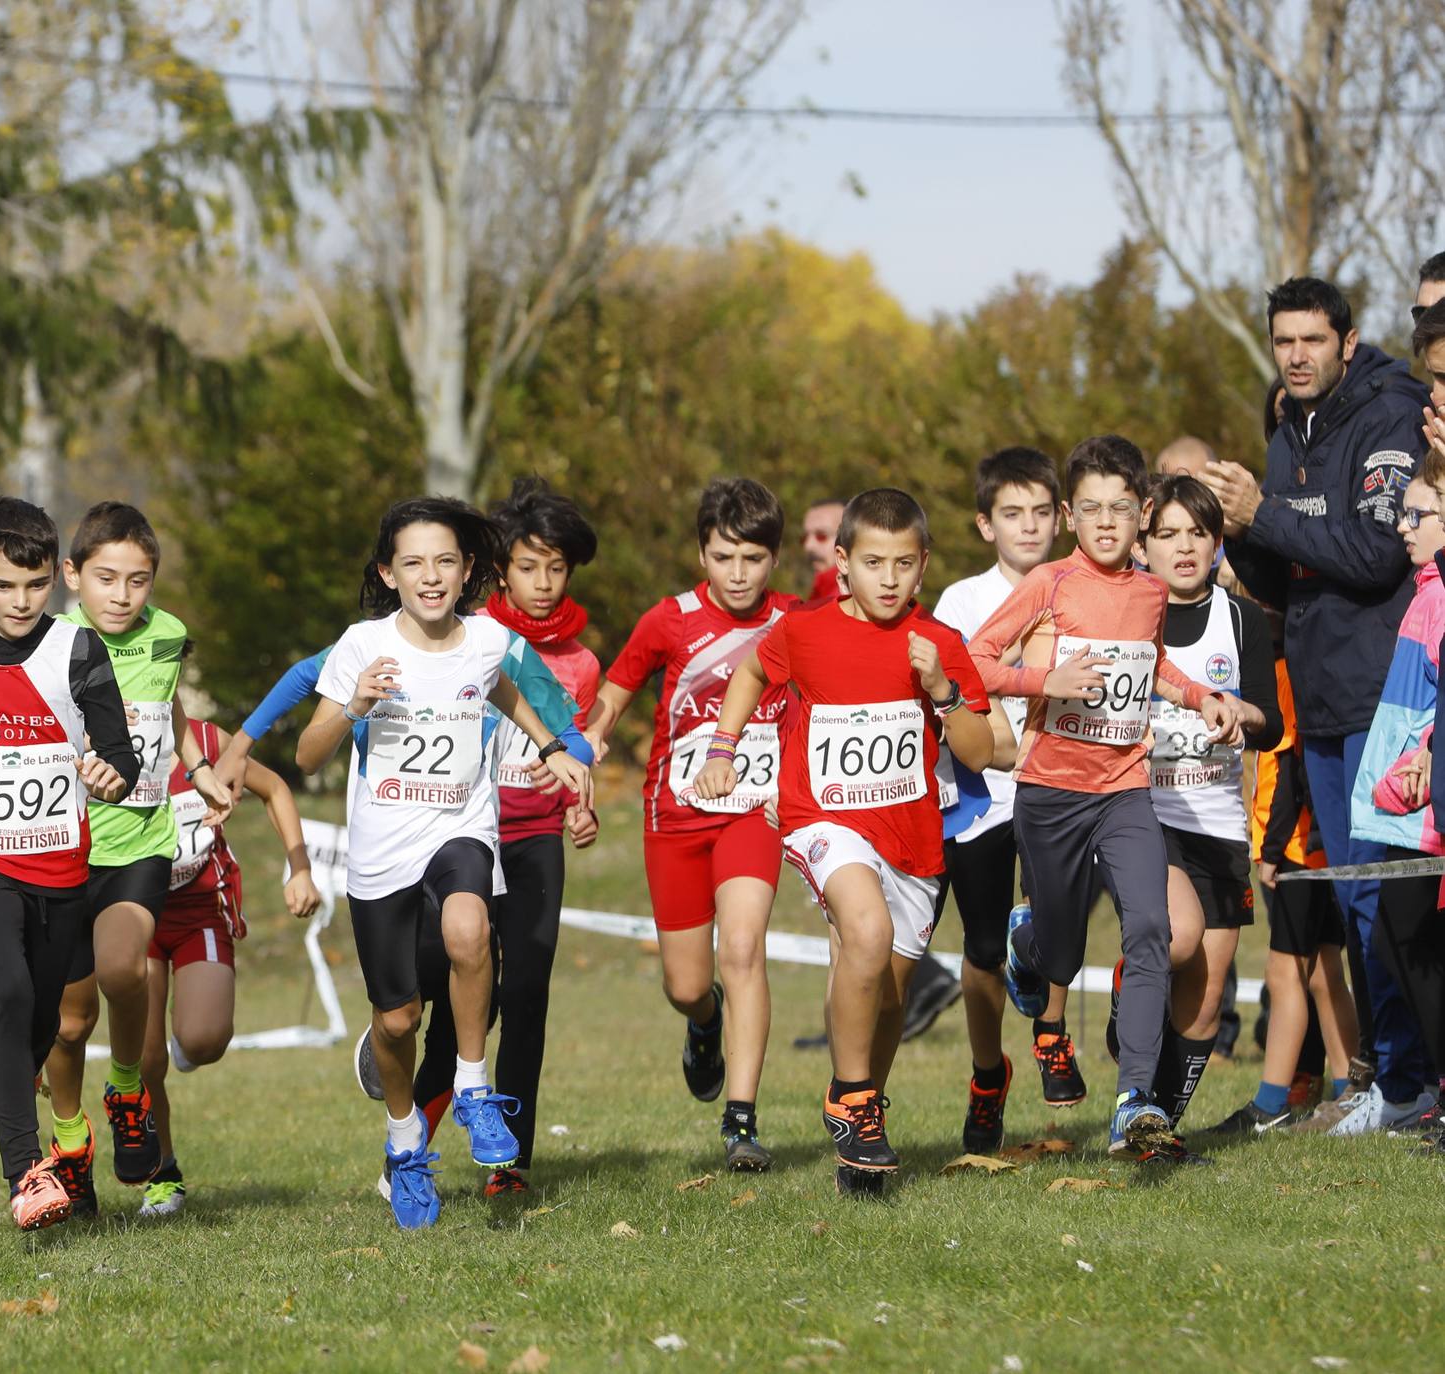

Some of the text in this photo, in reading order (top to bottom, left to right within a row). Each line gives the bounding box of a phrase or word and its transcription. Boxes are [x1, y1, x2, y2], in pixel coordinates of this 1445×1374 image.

[371, 711, 481, 722] Gobierno de La Rioja
[812, 710, 922, 726] Gobierno de La Rioja
[1083, 723, 1141, 740] ATLETISMO
[23, 756, 37, 766] de
[39, 755, 51, 765] La
[53, 753, 75, 765] Rioja
[400, 735, 454, 775] 22
[815, 729, 918, 777] 1606
[680, 748, 773, 786] 193
[1156, 770, 1223, 787] ATLETISMO
[405, 787, 470, 805] ATLETISMO
[848, 781, 917, 804] ATLETISMO
